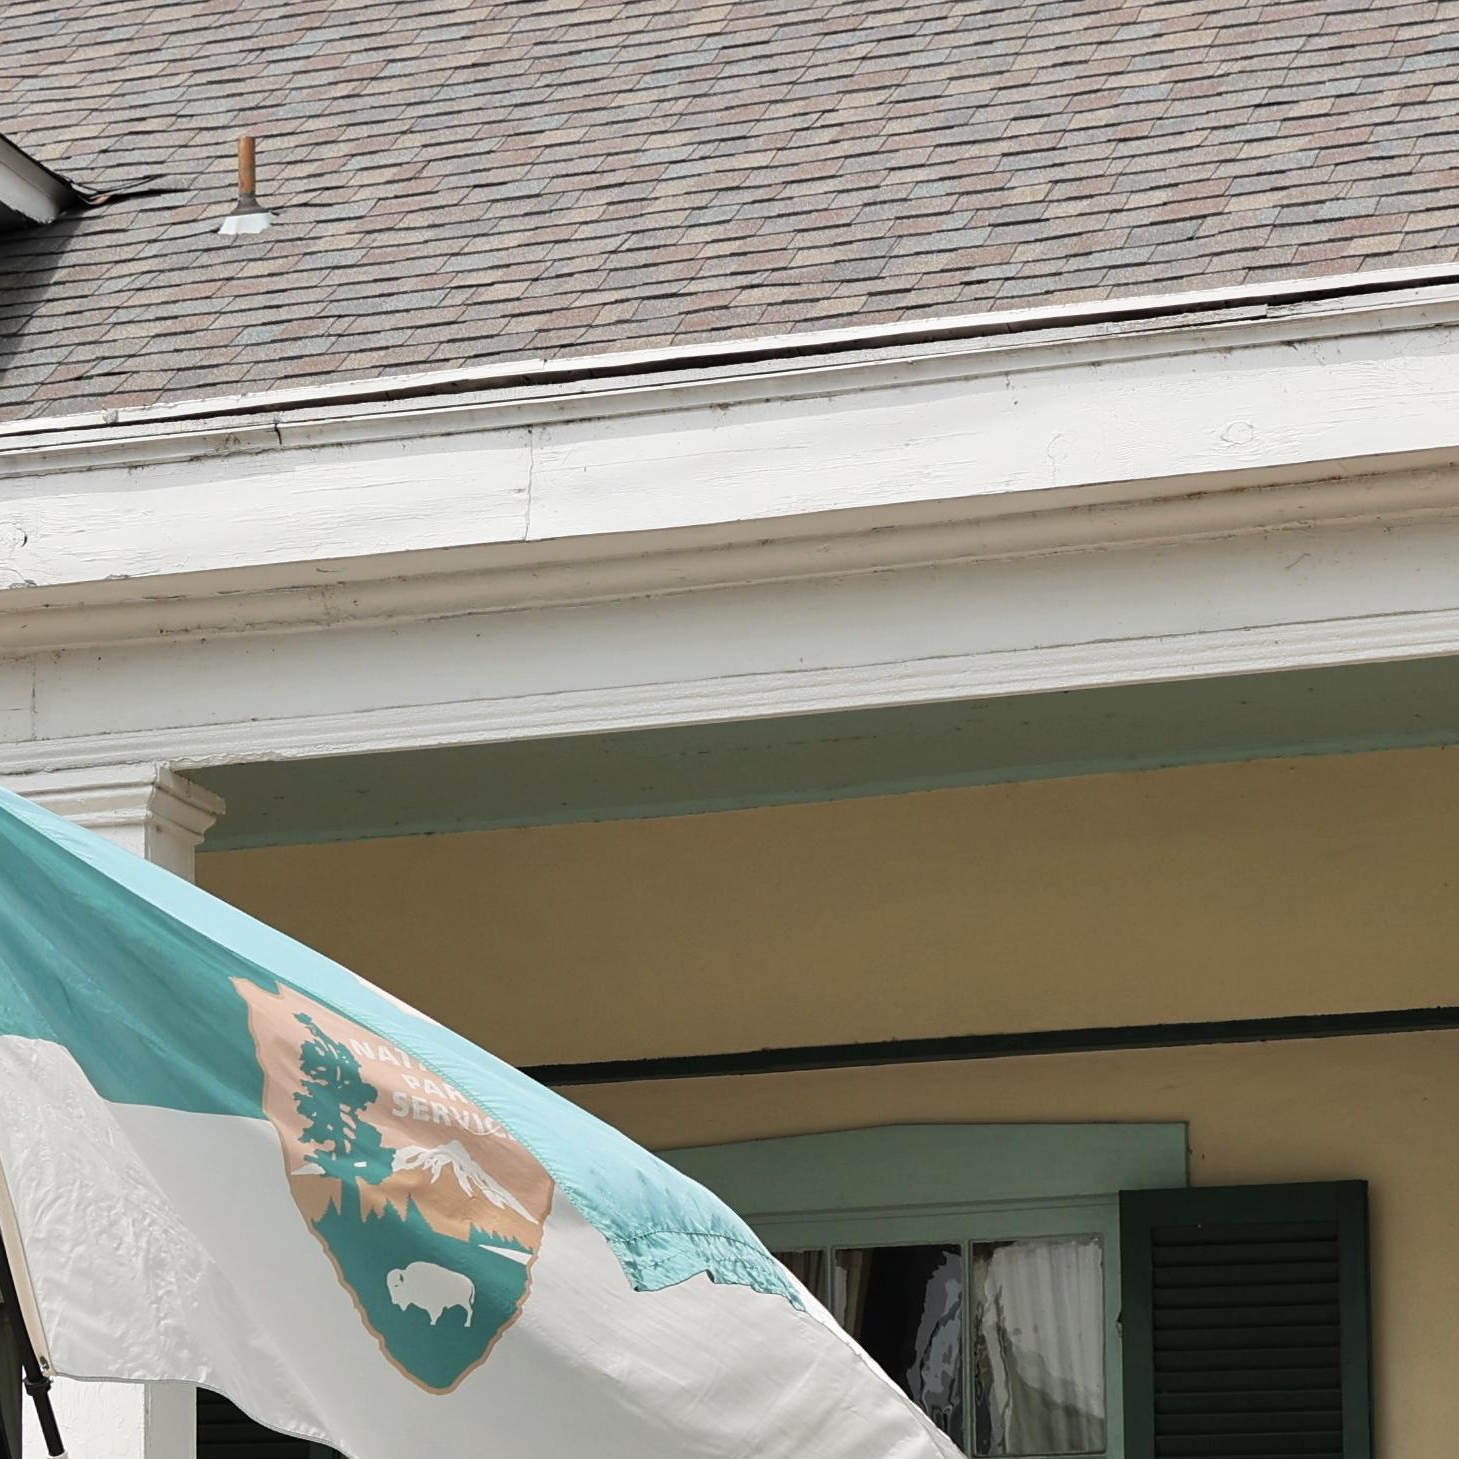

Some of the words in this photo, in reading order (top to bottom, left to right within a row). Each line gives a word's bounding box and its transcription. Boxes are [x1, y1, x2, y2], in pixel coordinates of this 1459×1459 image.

[348, 1038, 426, 1071] NAT
[401, 1073, 471, 1104] PAR
[391, 1091, 513, 1141] SERVIC
